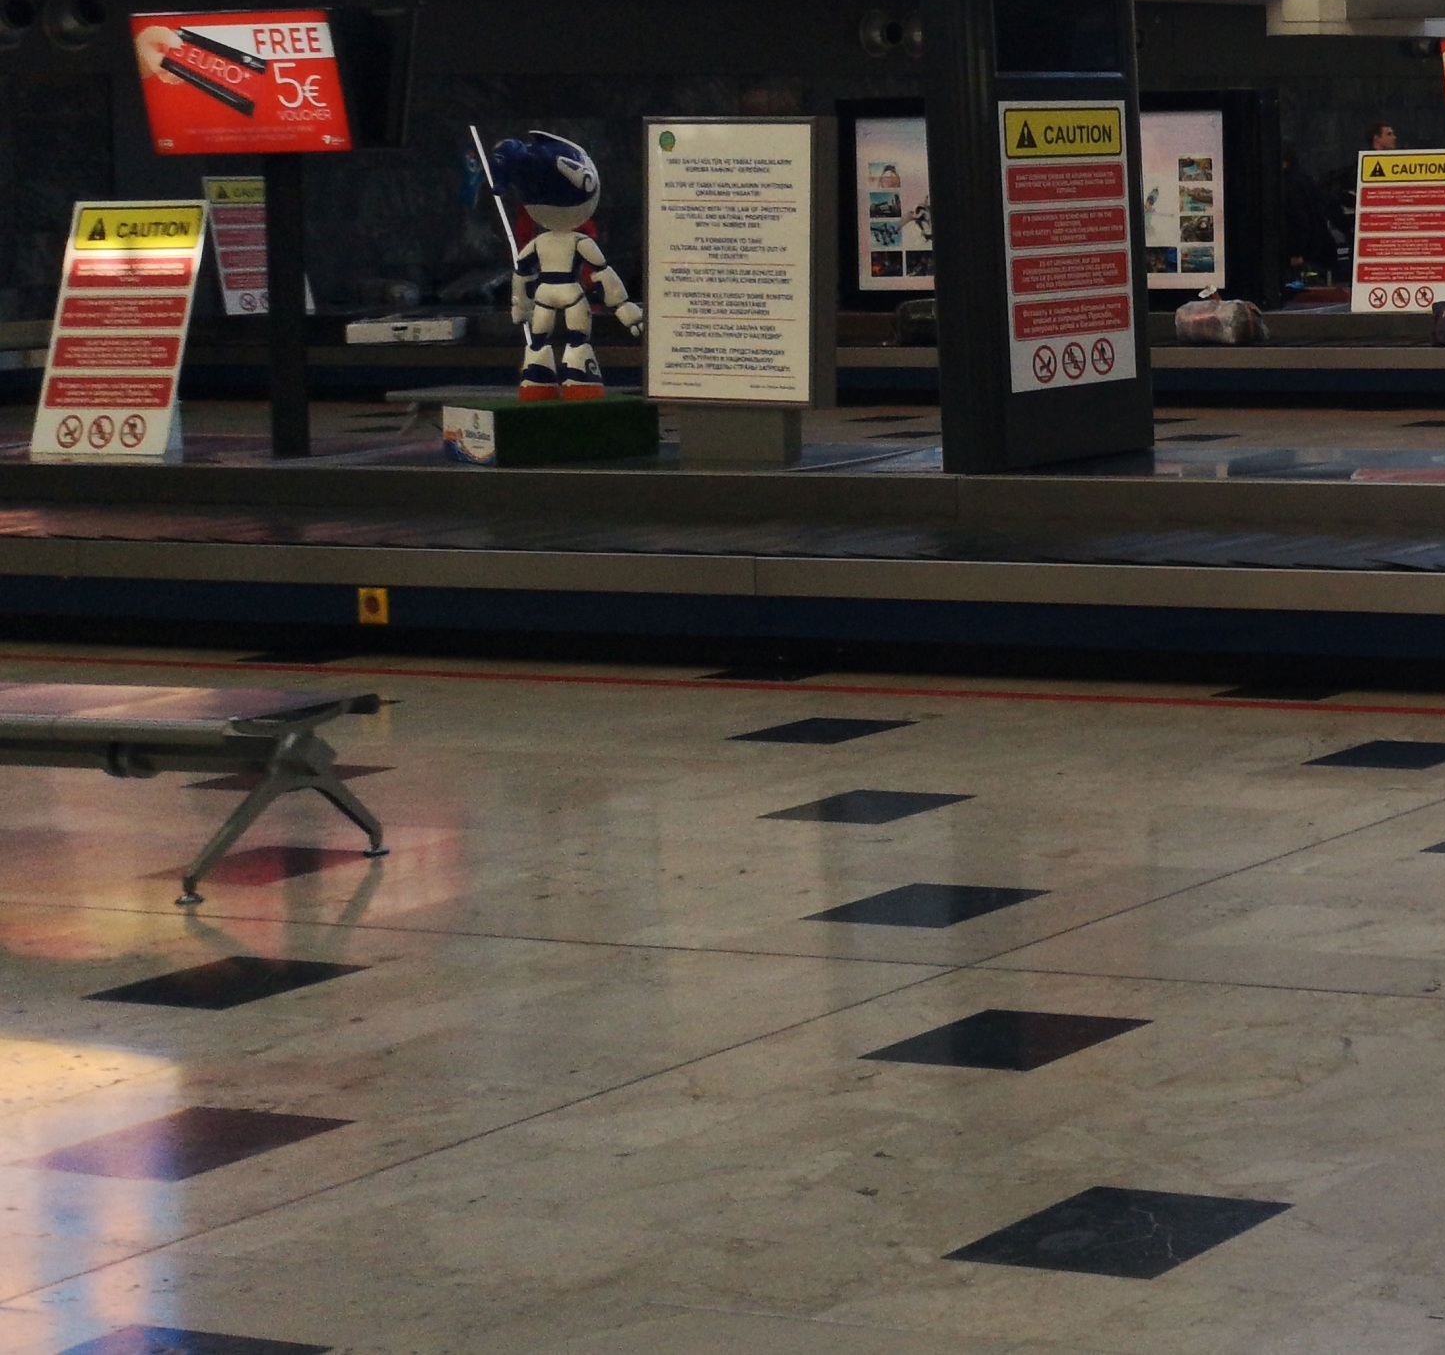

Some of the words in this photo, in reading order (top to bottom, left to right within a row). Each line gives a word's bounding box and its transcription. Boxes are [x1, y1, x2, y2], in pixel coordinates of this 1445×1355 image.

[252, 27, 323, 55] FREE
[273, 62, 327, 108] 5€
[278, 109, 333, 122] VOUCHER
[1043, 124, 1112, 145] CAUTION
[116, 221, 191, 238] CAUTION
